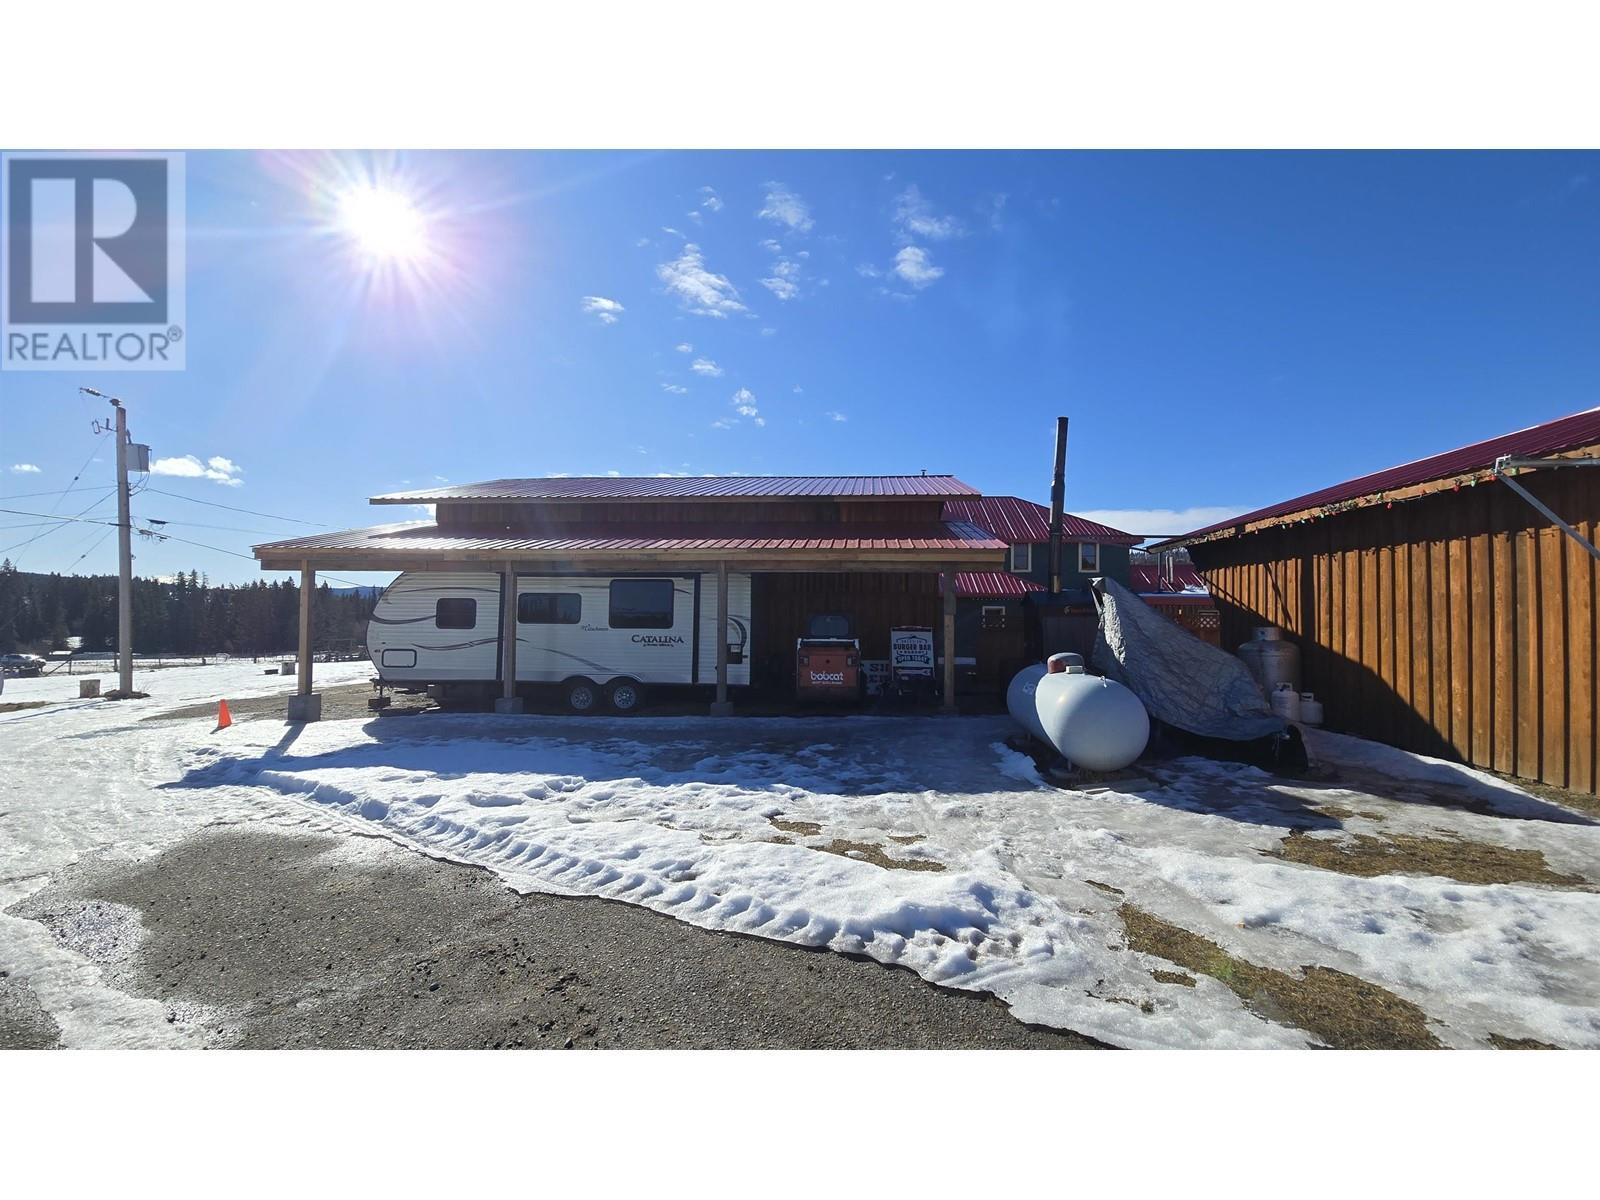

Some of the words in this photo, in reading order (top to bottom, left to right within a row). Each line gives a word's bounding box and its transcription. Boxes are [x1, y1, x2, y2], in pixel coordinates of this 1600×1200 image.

[631, 634, 685, 644] CATALINA
[919, 643, 931, 651] BAR
[810, 671, 844, 681] bobcat
